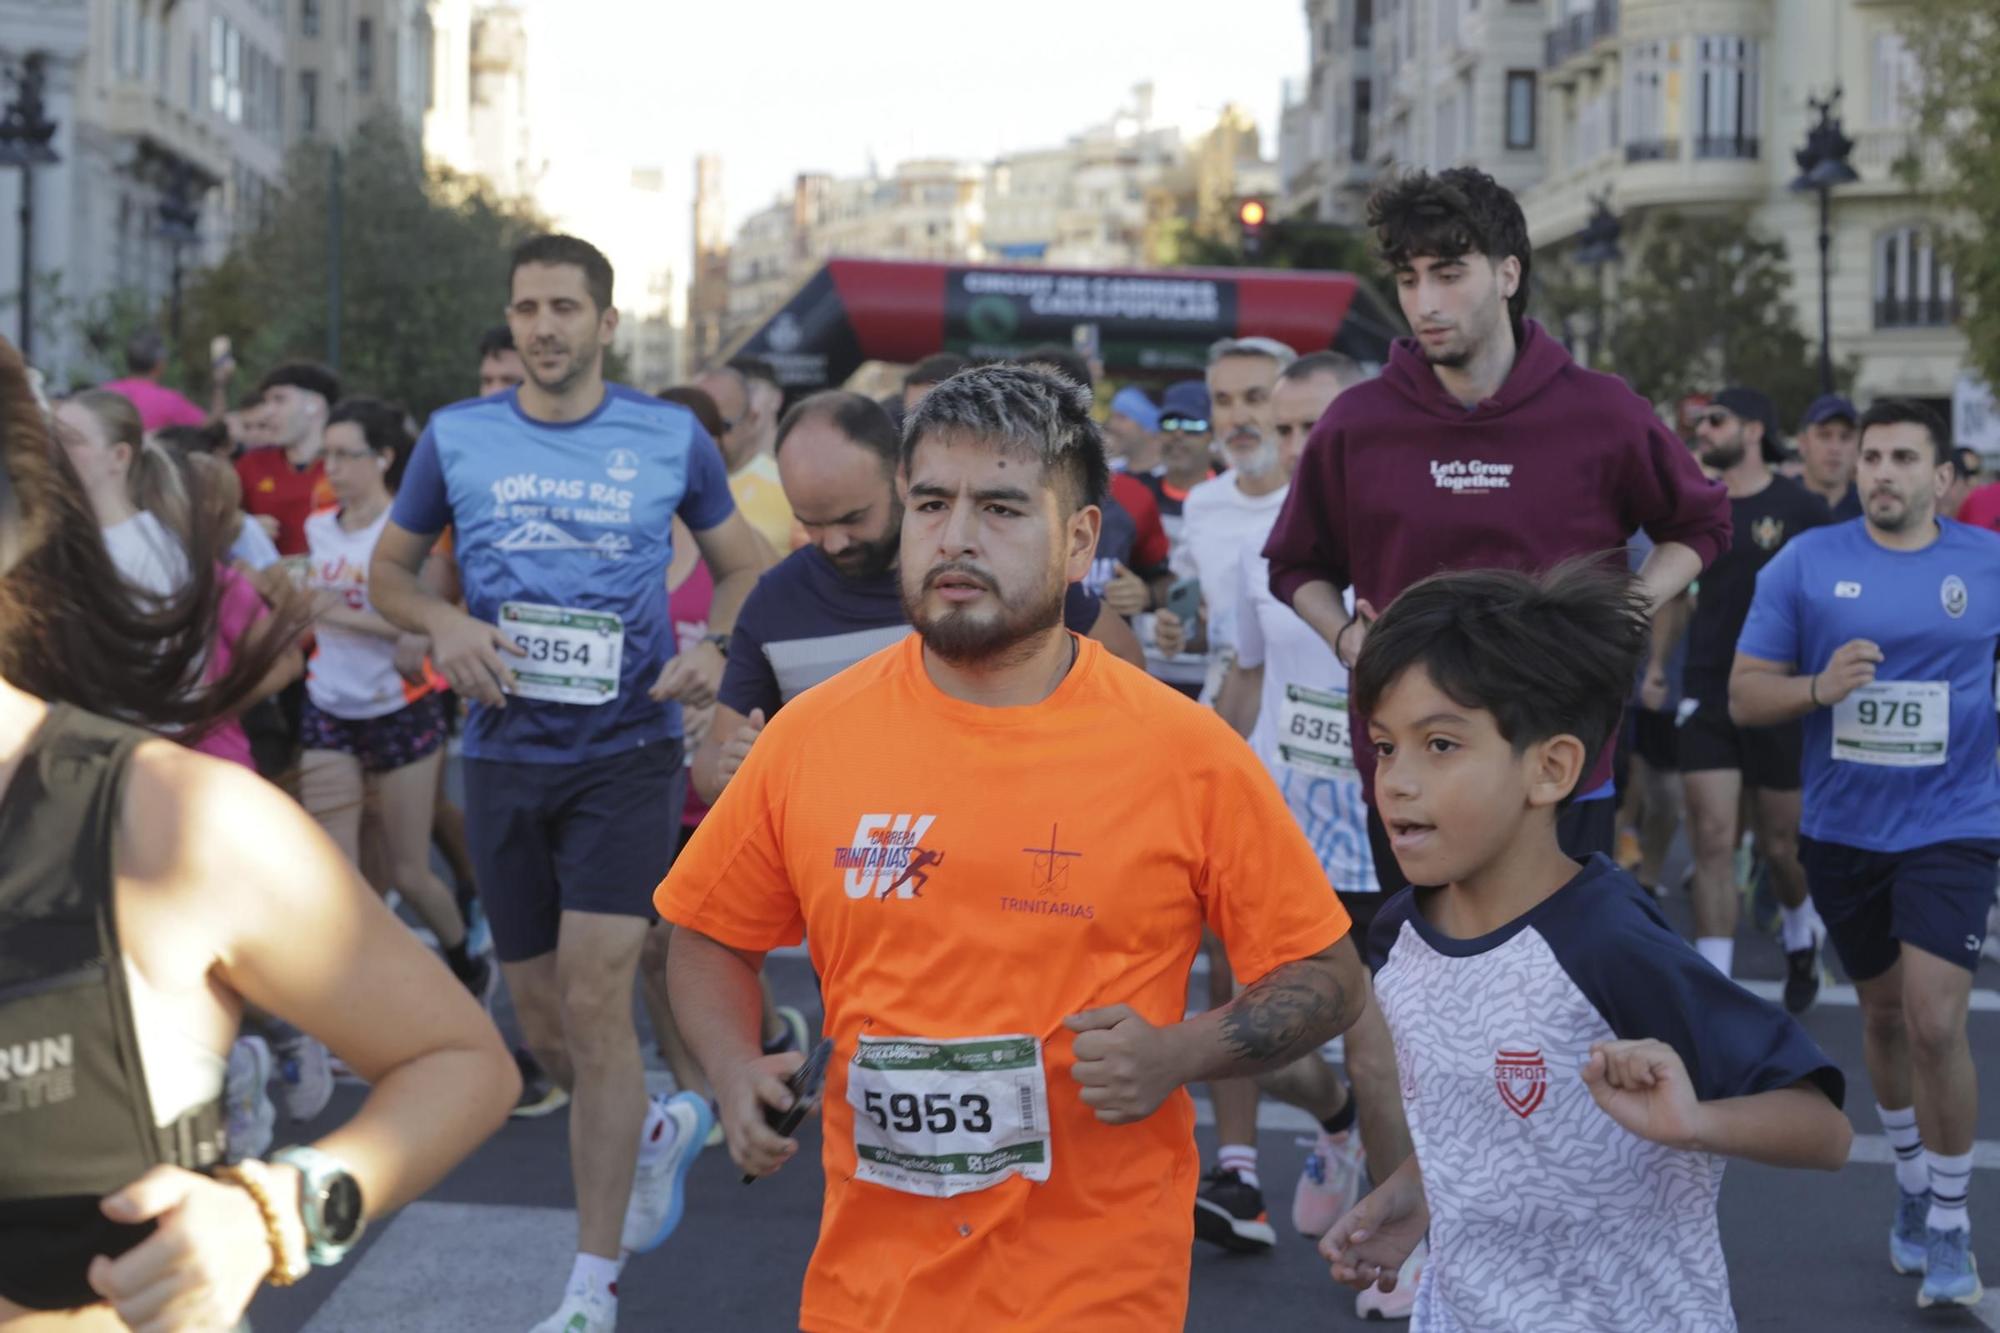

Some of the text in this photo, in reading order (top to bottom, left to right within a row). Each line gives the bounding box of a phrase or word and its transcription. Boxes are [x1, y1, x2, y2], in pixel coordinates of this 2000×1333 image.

[1430, 460, 1514, 475] Let's Grow
[491, 473, 634, 509] 10K PAS RAS
[1434, 474, 1511, 490] Together.
[1858, 699, 1922, 727] 976
[1290, 713, 1352, 748] 635
[871, 831, 917, 846] CARRERA
[834, 847, 913, 868] TRINITARIAS
[843, 813, 936, 900] 5K
[999, 896, 1095, 920] TRINITARIAS
[1495, 1066, 1547, 1081] DETROIT
[864, 1090, 993, 1134] 5953
